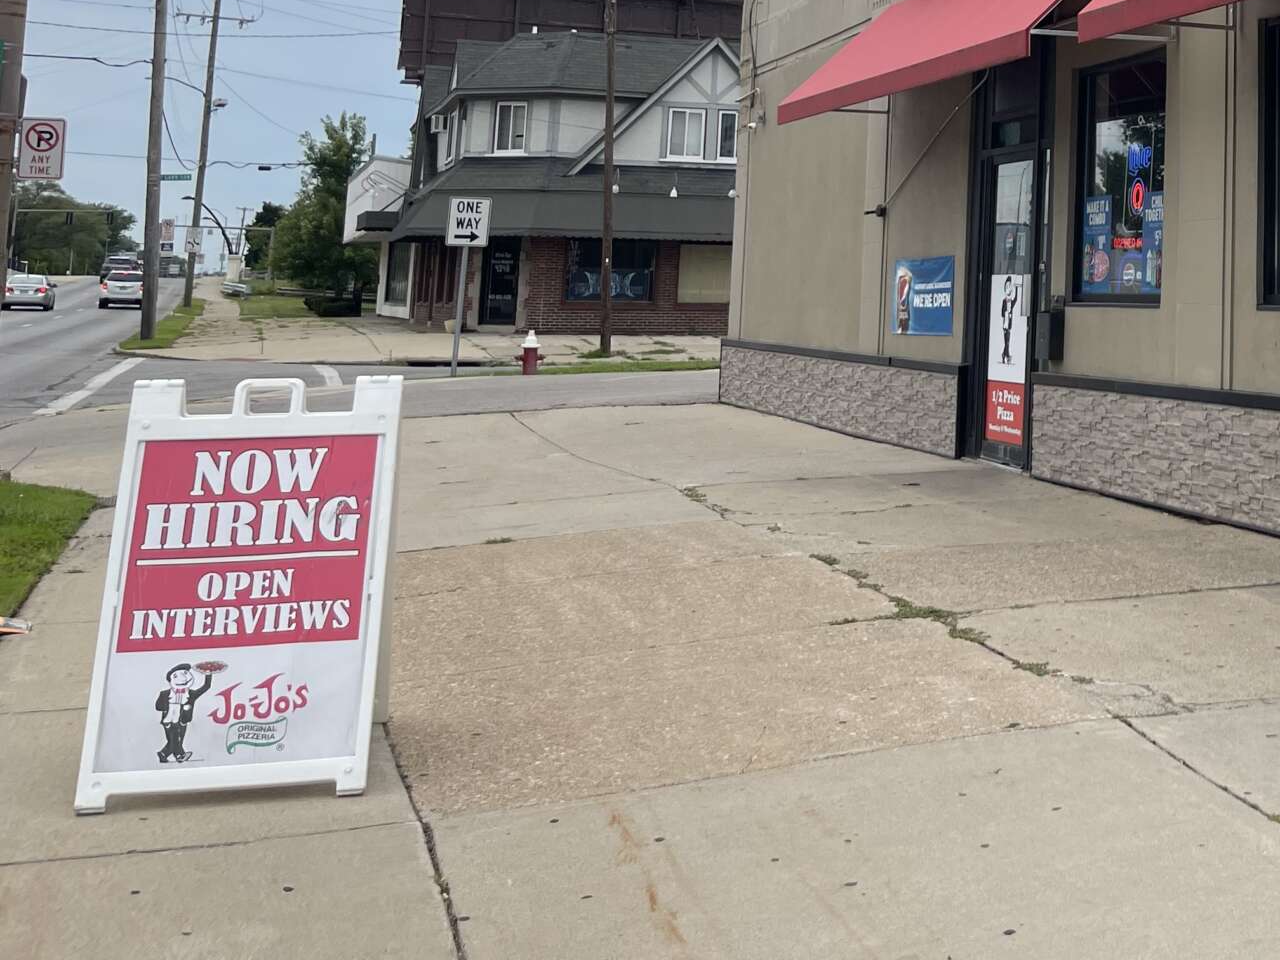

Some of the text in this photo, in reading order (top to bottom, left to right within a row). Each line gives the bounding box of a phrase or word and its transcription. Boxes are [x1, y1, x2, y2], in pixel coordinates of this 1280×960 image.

[30, 155, 51, 164] ANY
[29, 166, 52, 175] TIME
[457, 201, 483, 214] ONE
[456, 217, 482, 230] WAY
[933, 292, 951, 308] OPEN
[992, 389, 1021, 405] 1/2 Price
[997, 406, 1014, 421] Pizza
[191, 447, 329, 496] NOW
[140, 496, 360, 550] HIRING
[197, 569, 294, 602] OPEN
[129, 600, 350, 640] INTERVIEWS
[237, 725, 278, 733] ORIGINAL
[237, 733, 276, 741] PIZZERIA
